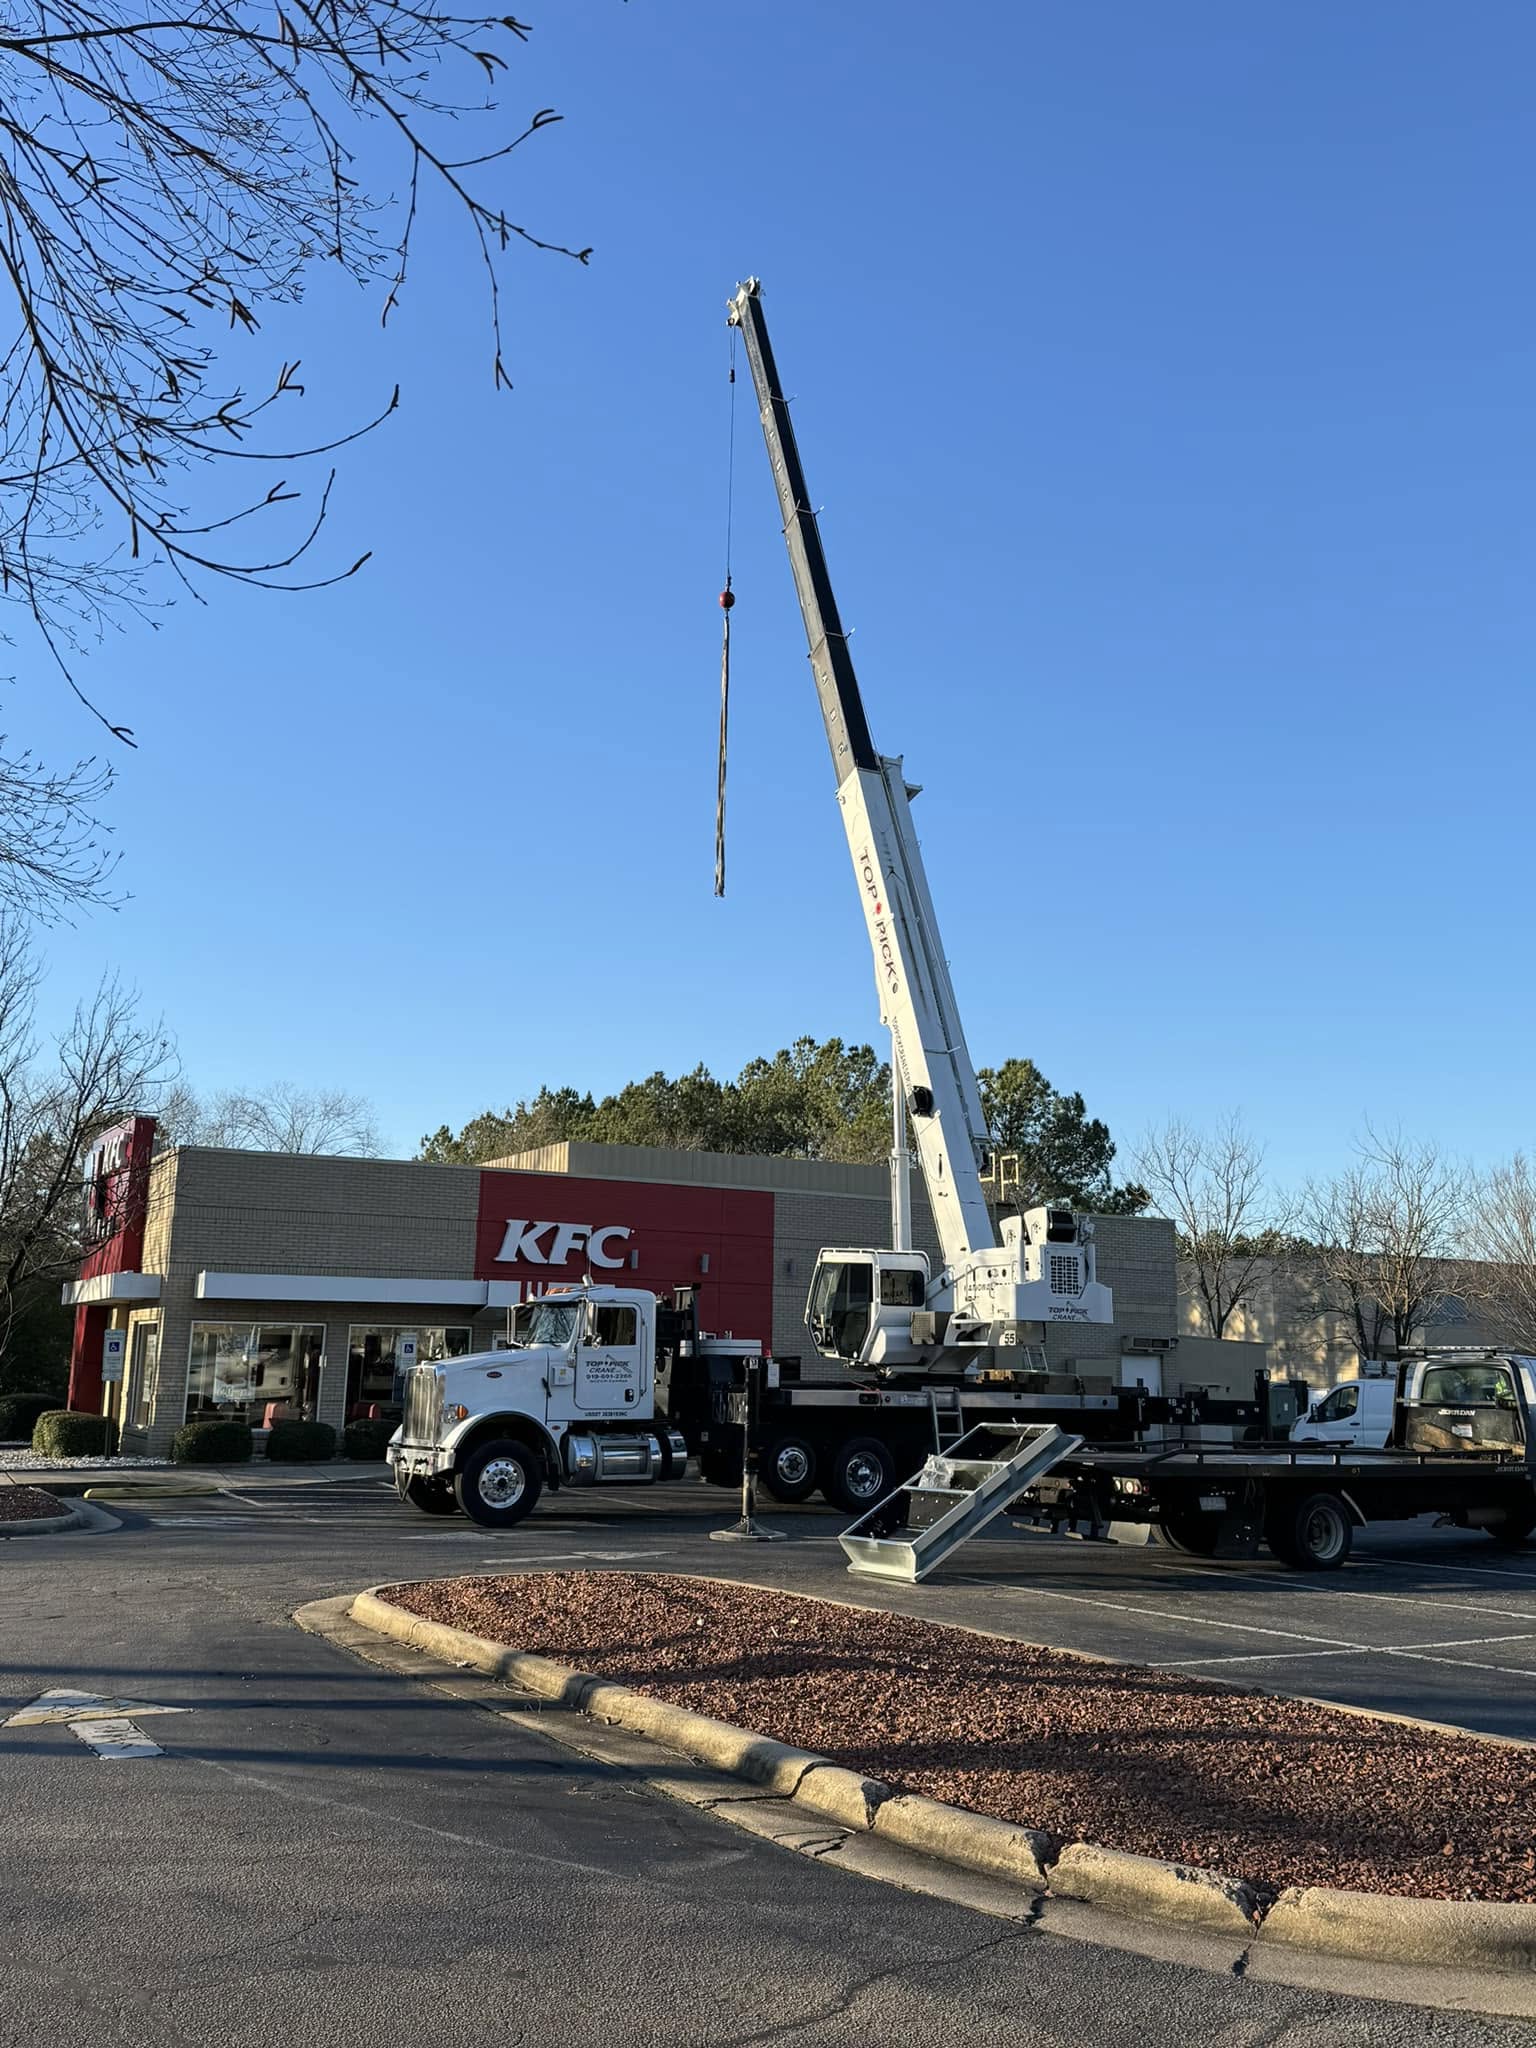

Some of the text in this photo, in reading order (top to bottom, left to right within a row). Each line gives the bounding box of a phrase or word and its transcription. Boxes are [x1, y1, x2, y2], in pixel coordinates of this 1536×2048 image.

[860, 848, 897, 978] TOP PICK
[494, 1218, 631, 1268] KFC
[1004, 1333, 1015, 1344] 55
